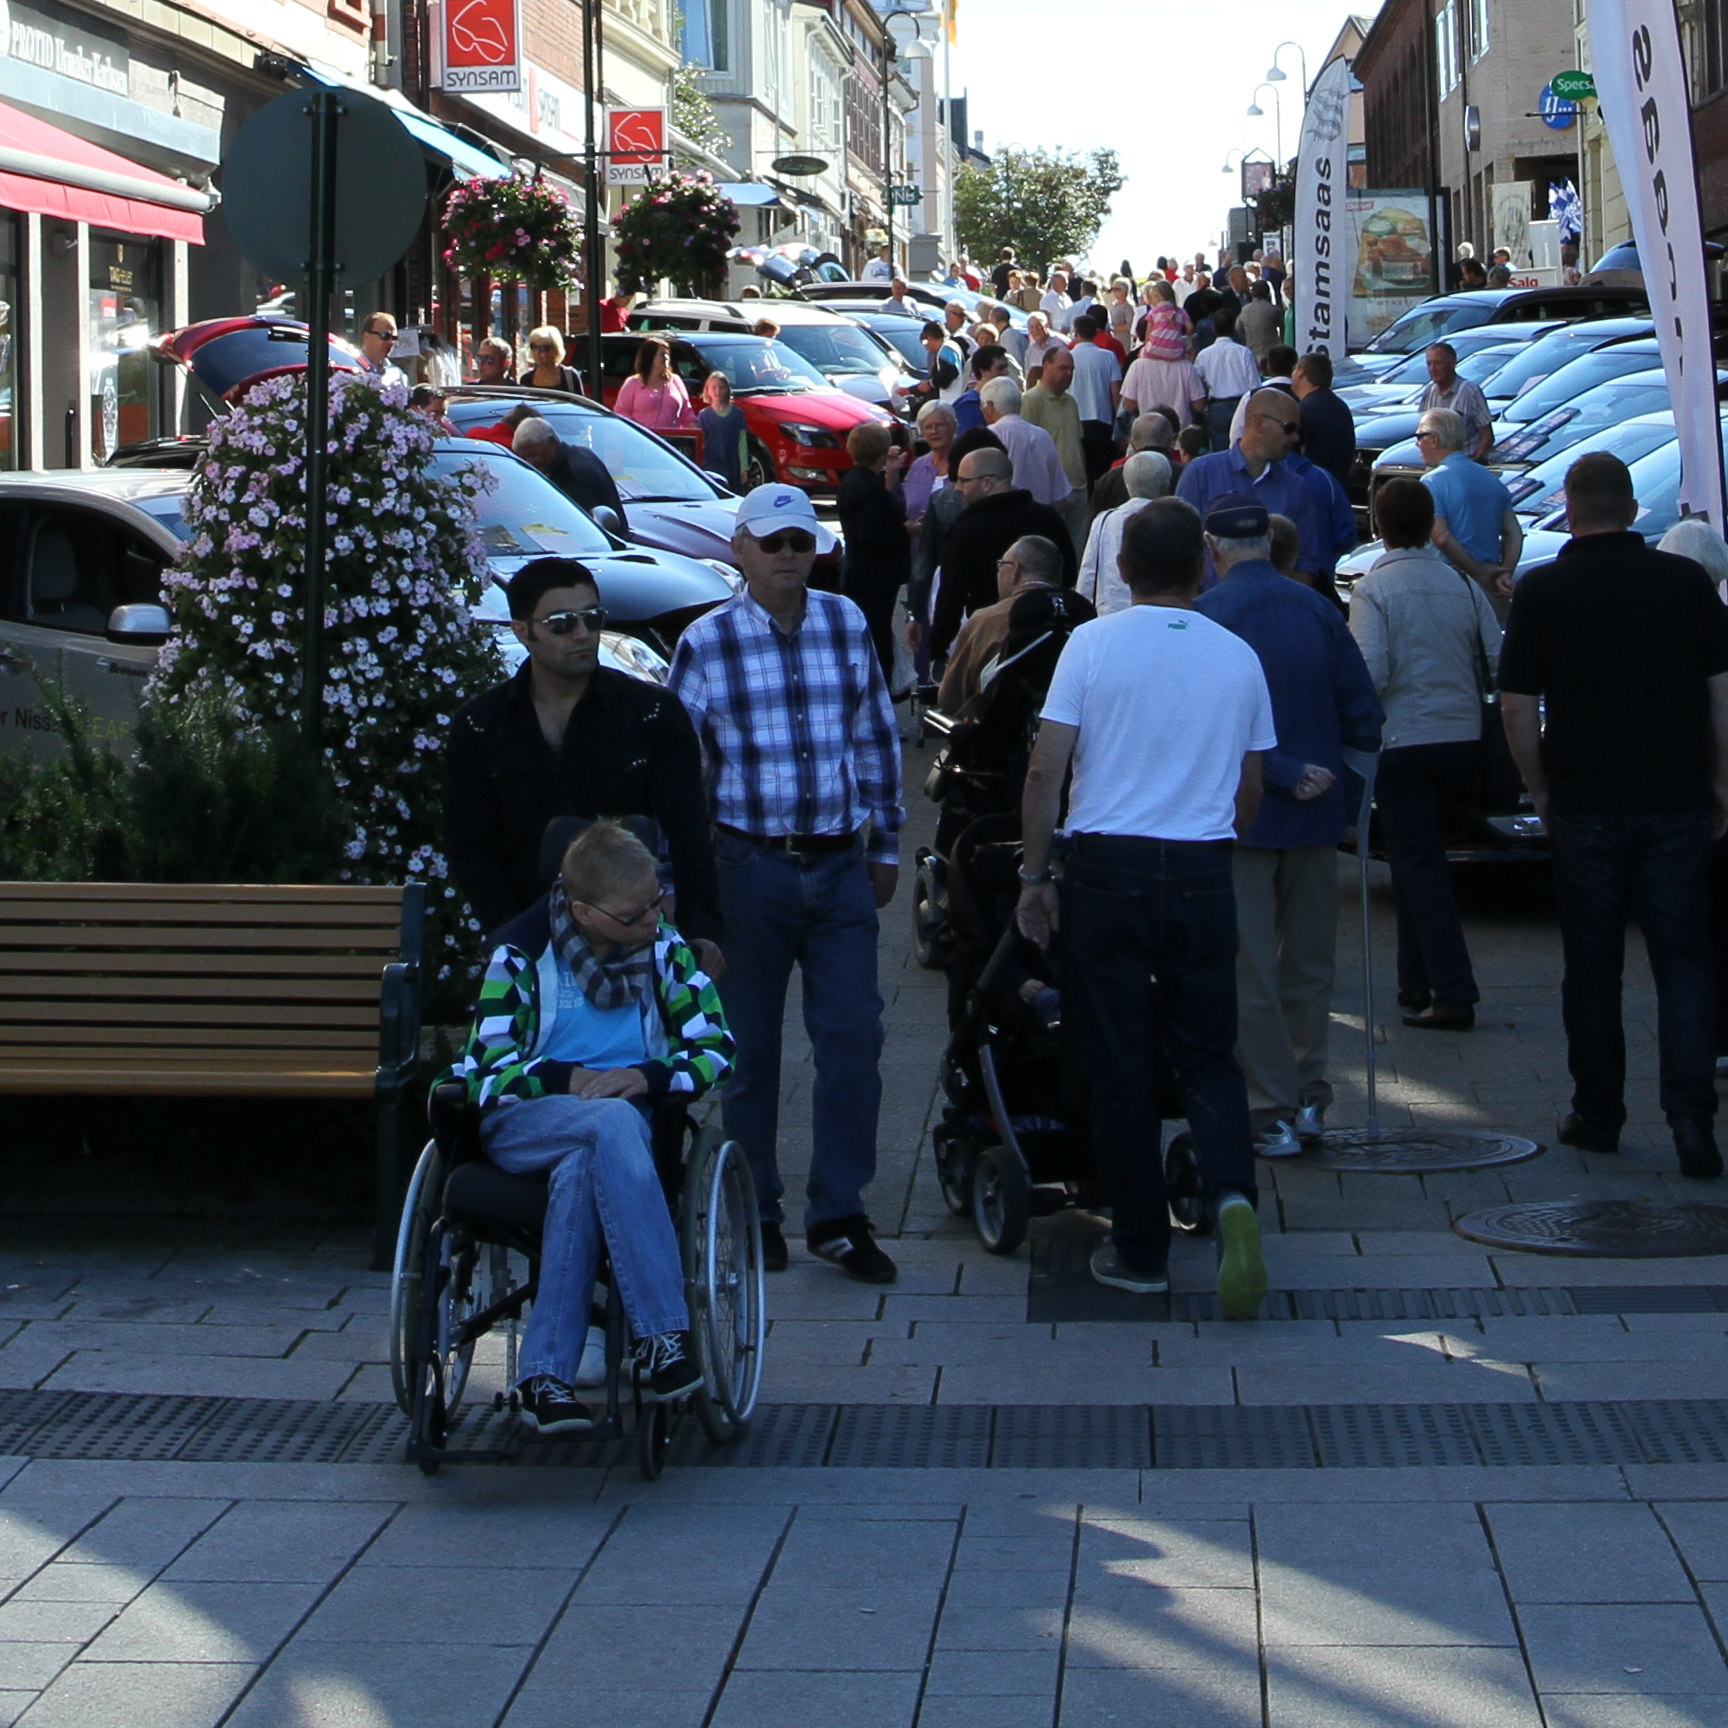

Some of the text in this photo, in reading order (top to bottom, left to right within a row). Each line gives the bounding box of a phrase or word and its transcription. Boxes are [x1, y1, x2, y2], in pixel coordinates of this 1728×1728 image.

[11, 21, 54, 68] PROTID
[446, 70, 517, 87] SYNSAM
[1307, 156, 1332, 360] Stamsaas
[15, 708, 58, 733] Niss
